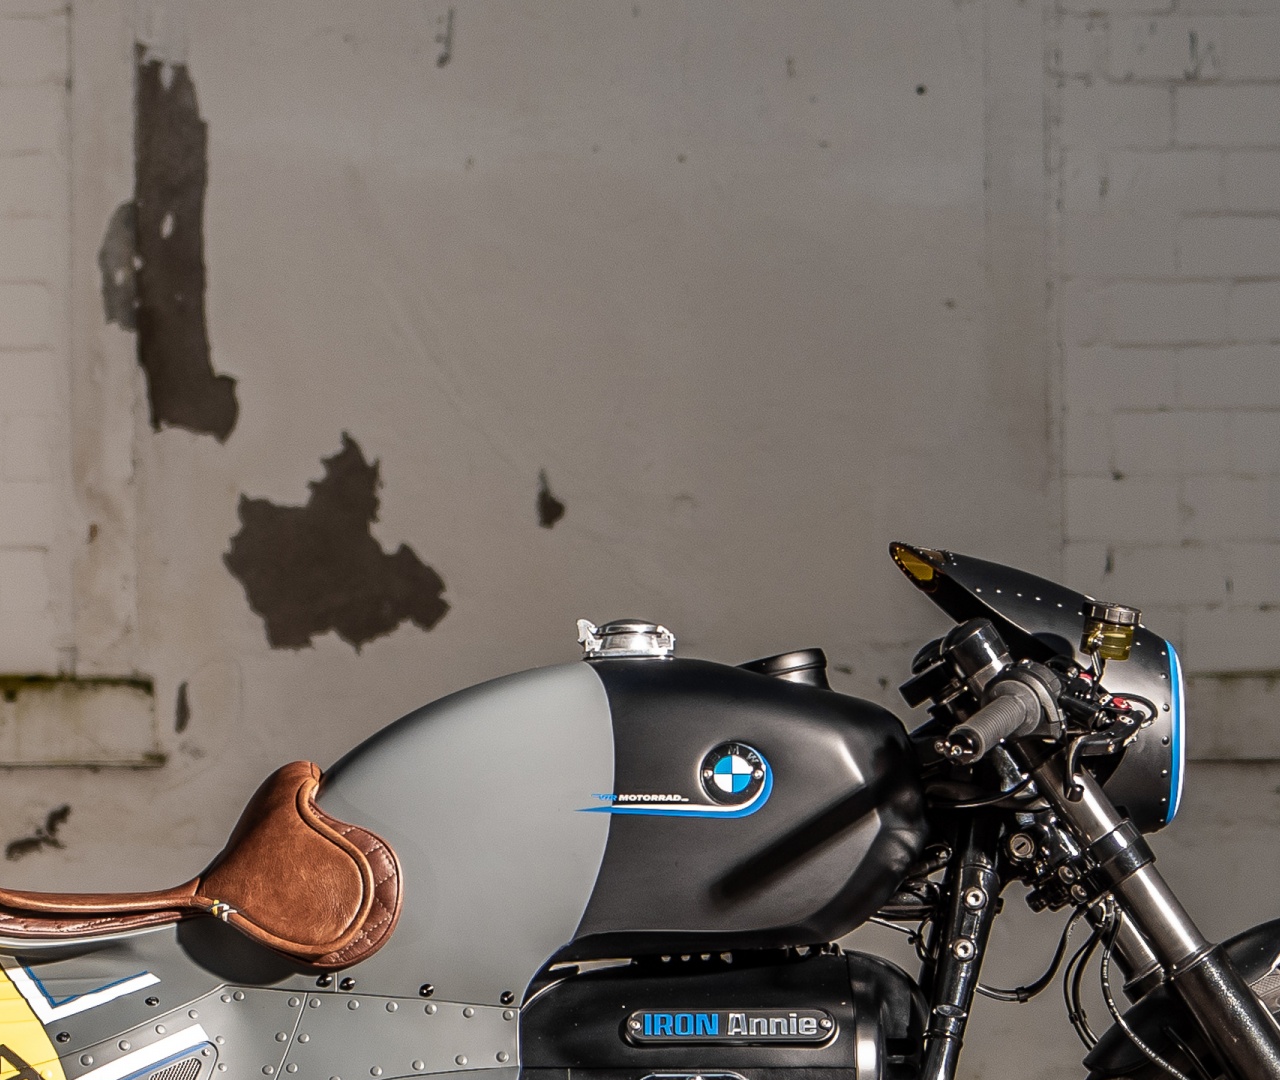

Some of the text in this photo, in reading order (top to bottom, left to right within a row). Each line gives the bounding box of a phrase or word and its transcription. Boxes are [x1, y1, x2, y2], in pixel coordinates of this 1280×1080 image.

[619, 794, 682, 802] MOTORRAD
[644, 1013, 817, 1036] IRON Annie
